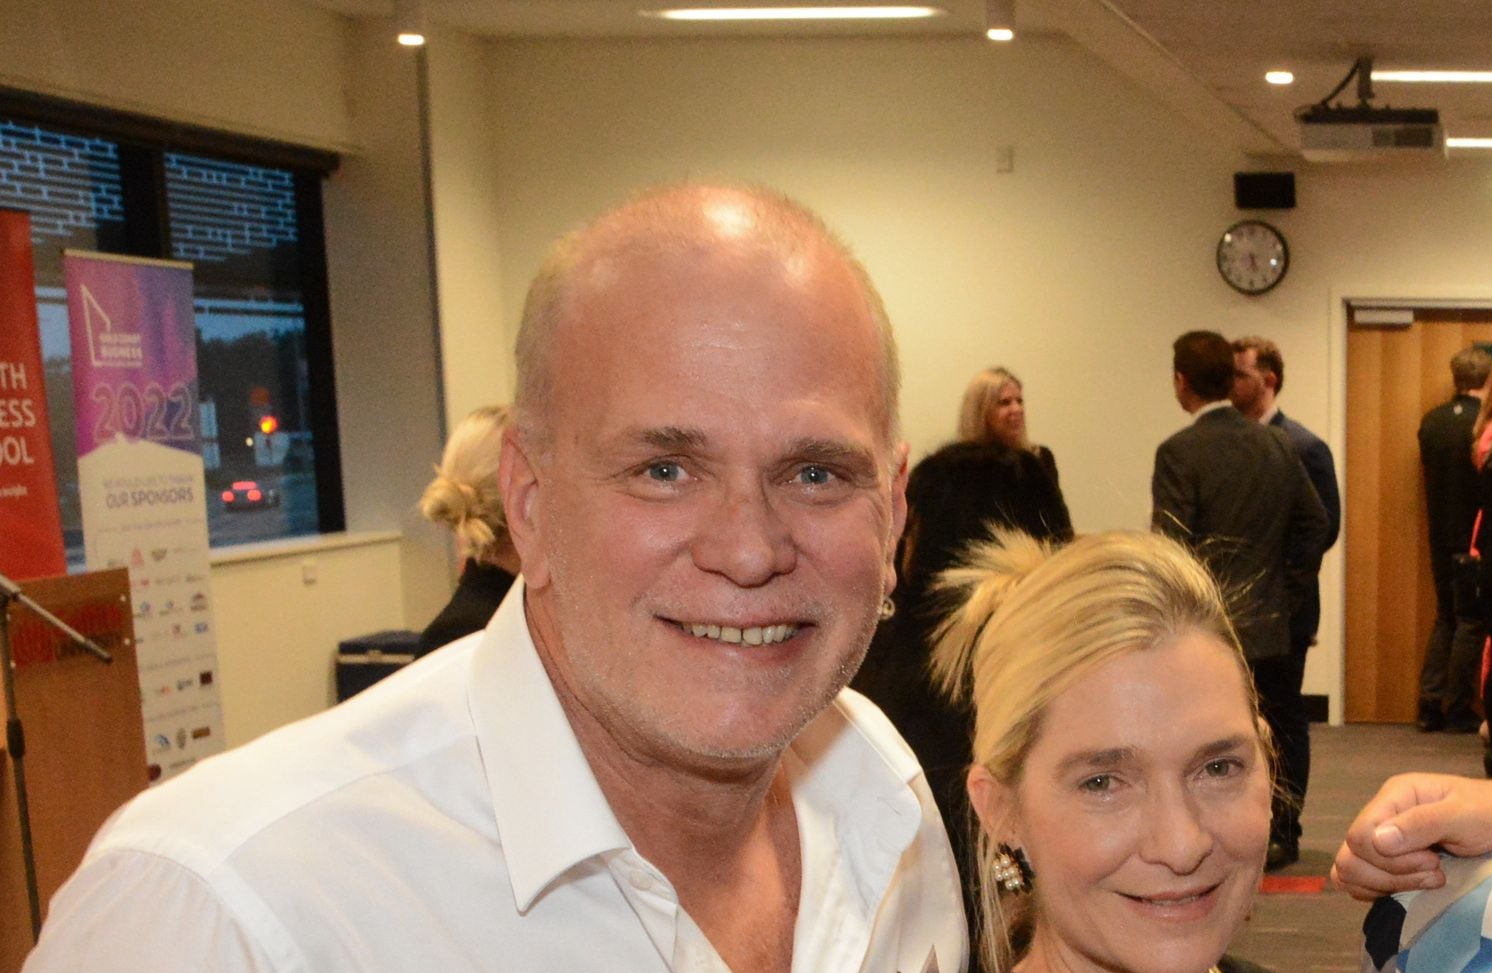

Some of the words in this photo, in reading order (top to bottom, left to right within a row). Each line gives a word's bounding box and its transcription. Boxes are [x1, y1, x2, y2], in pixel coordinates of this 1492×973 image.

[92, 382, 195, 441] 2022
[0, 436, 34, 465] OL
[131, 487, 194, 506] SPONSORS
